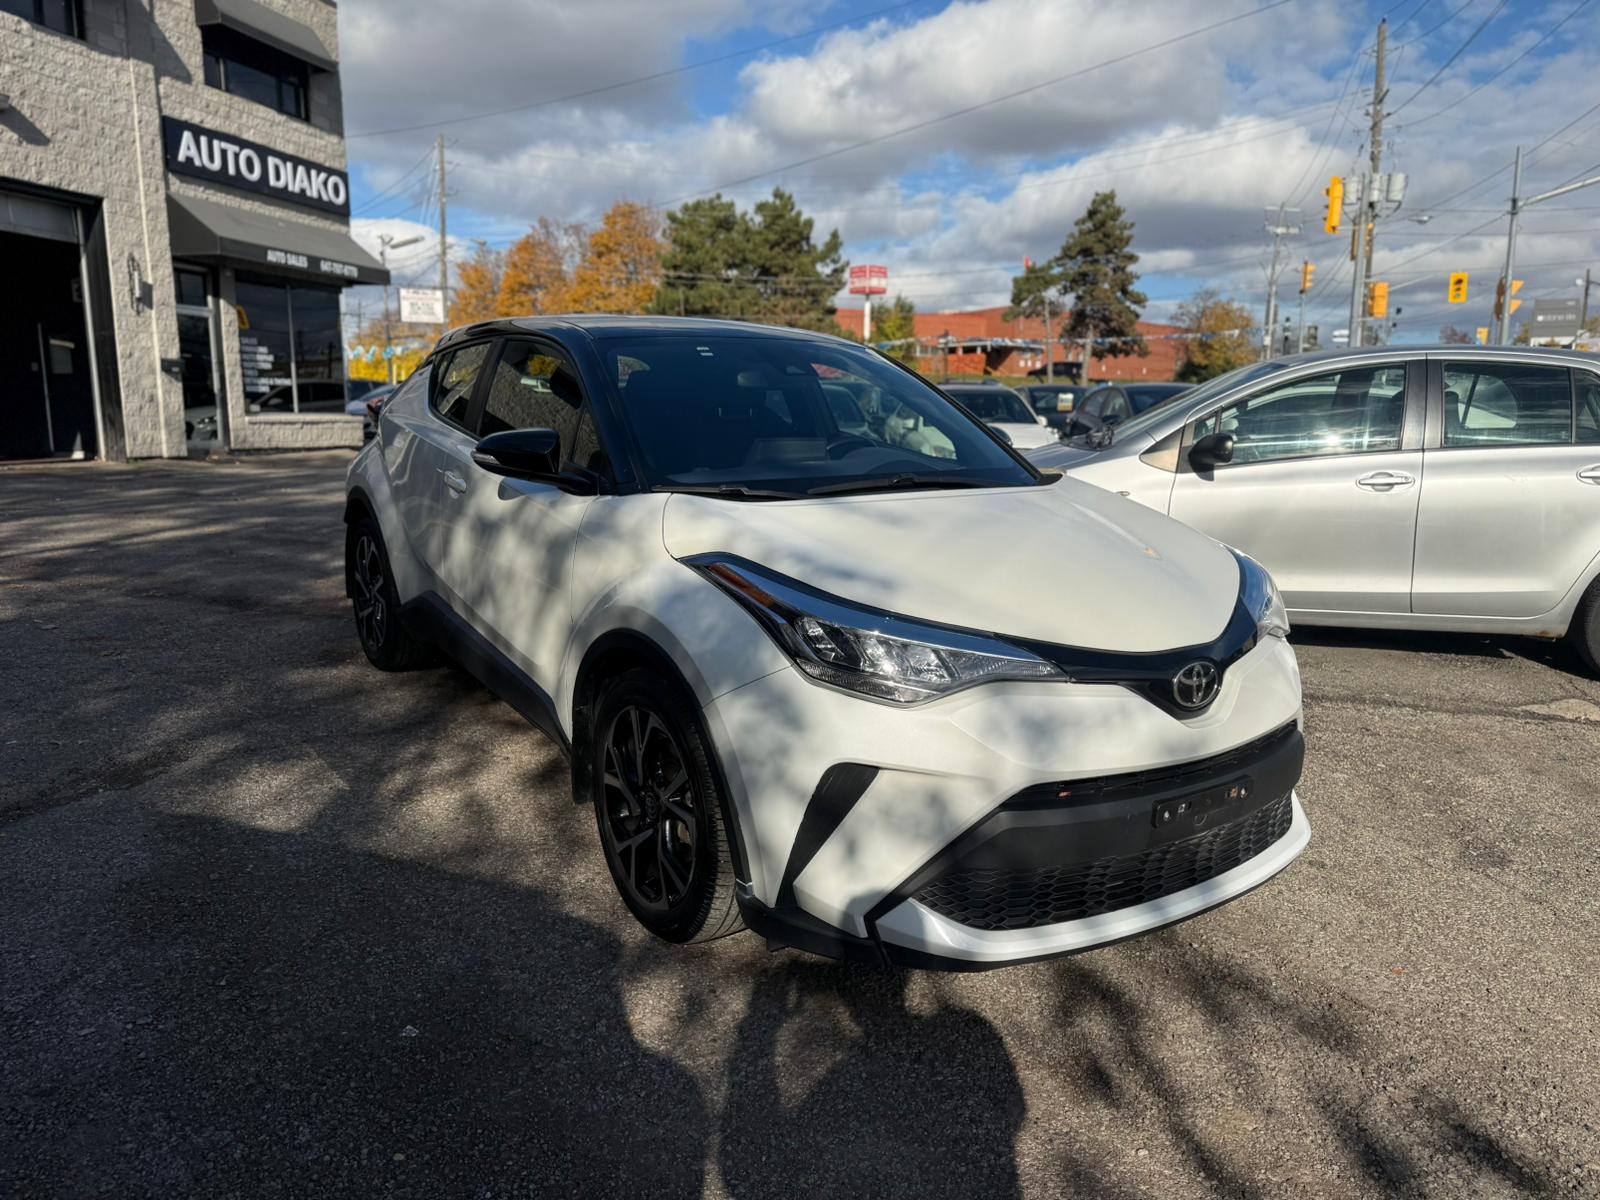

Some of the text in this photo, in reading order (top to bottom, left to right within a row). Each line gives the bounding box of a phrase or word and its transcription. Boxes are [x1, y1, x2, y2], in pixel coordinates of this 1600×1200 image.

[178, 130, 346, 205] AUTO DIAKO
[267, 250, 308, 268] AUTO SALES
